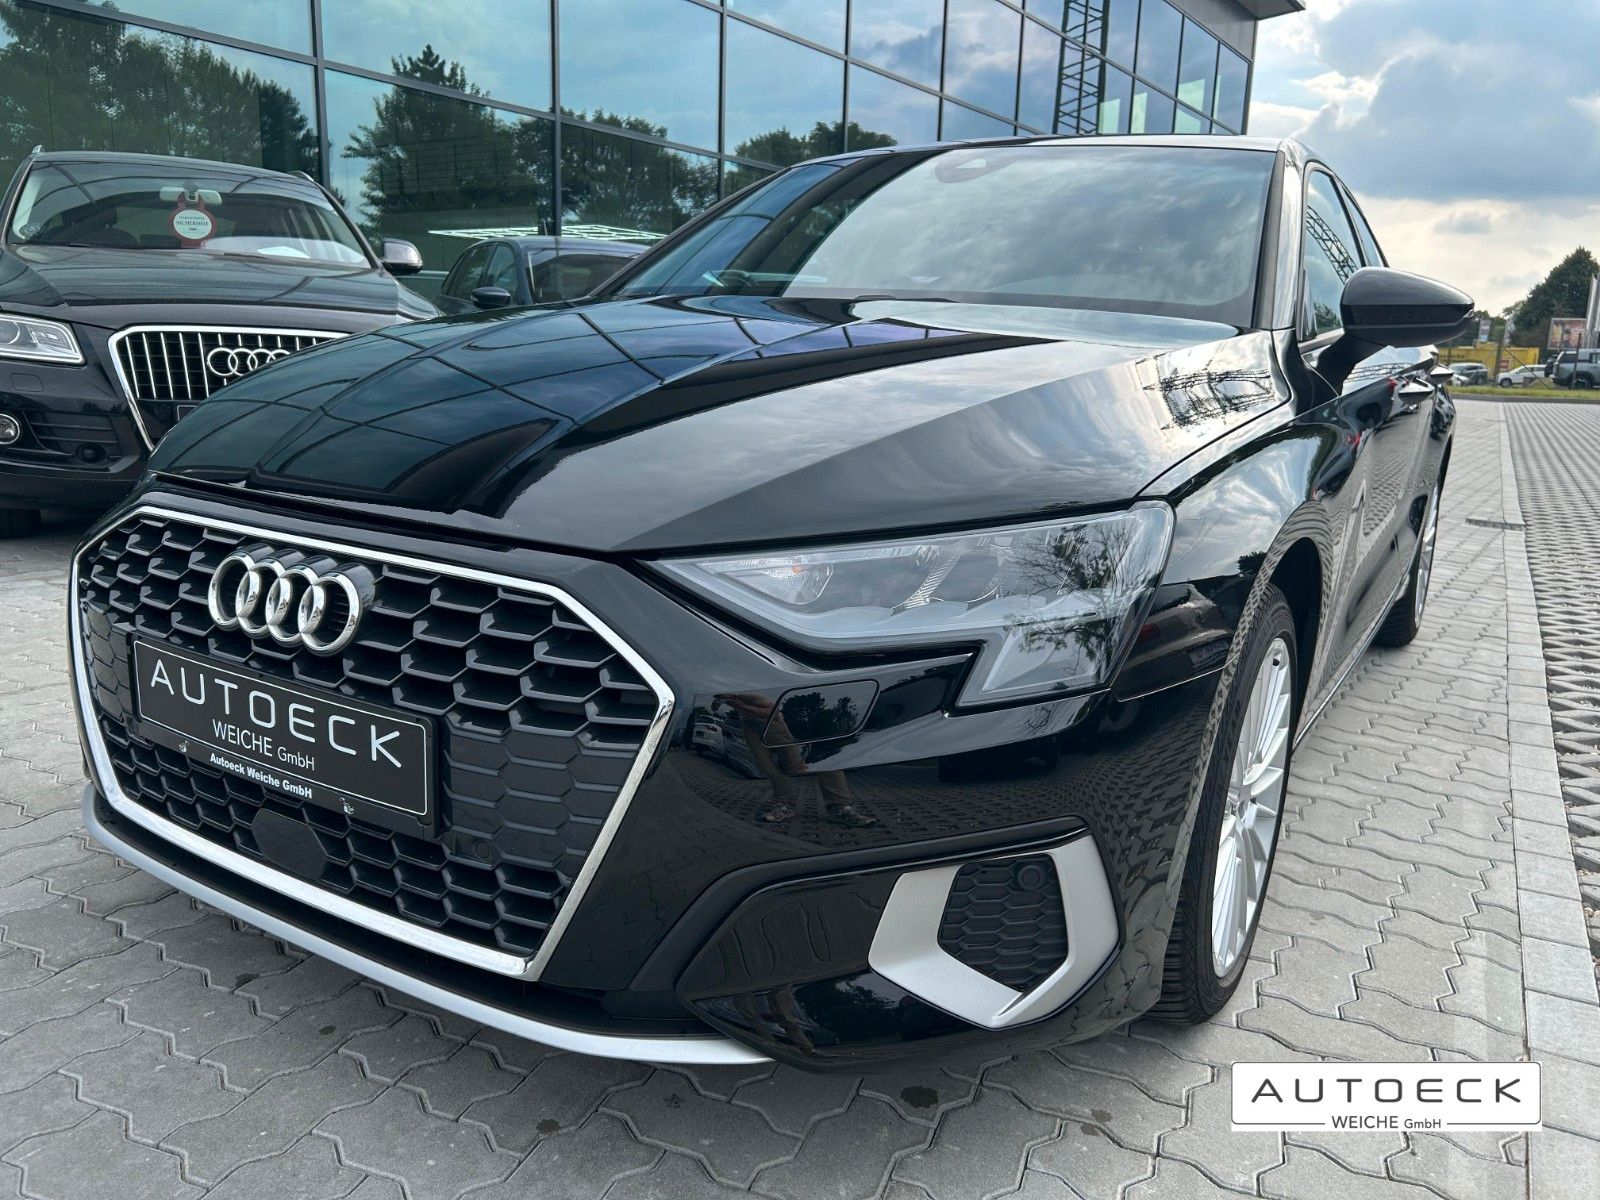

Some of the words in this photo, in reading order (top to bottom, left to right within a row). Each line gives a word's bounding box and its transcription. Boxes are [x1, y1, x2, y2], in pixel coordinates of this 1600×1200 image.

[151, 659, 401, 768] AUTOECK
[212, 718, 273, 758] WEICHE
[277, 746, 315, 771] GmbH
[209, 752, 245, 775] Autoeck
[246, 763, 280, 788] Weiche
[282, 778, 313, 799] GmbH
